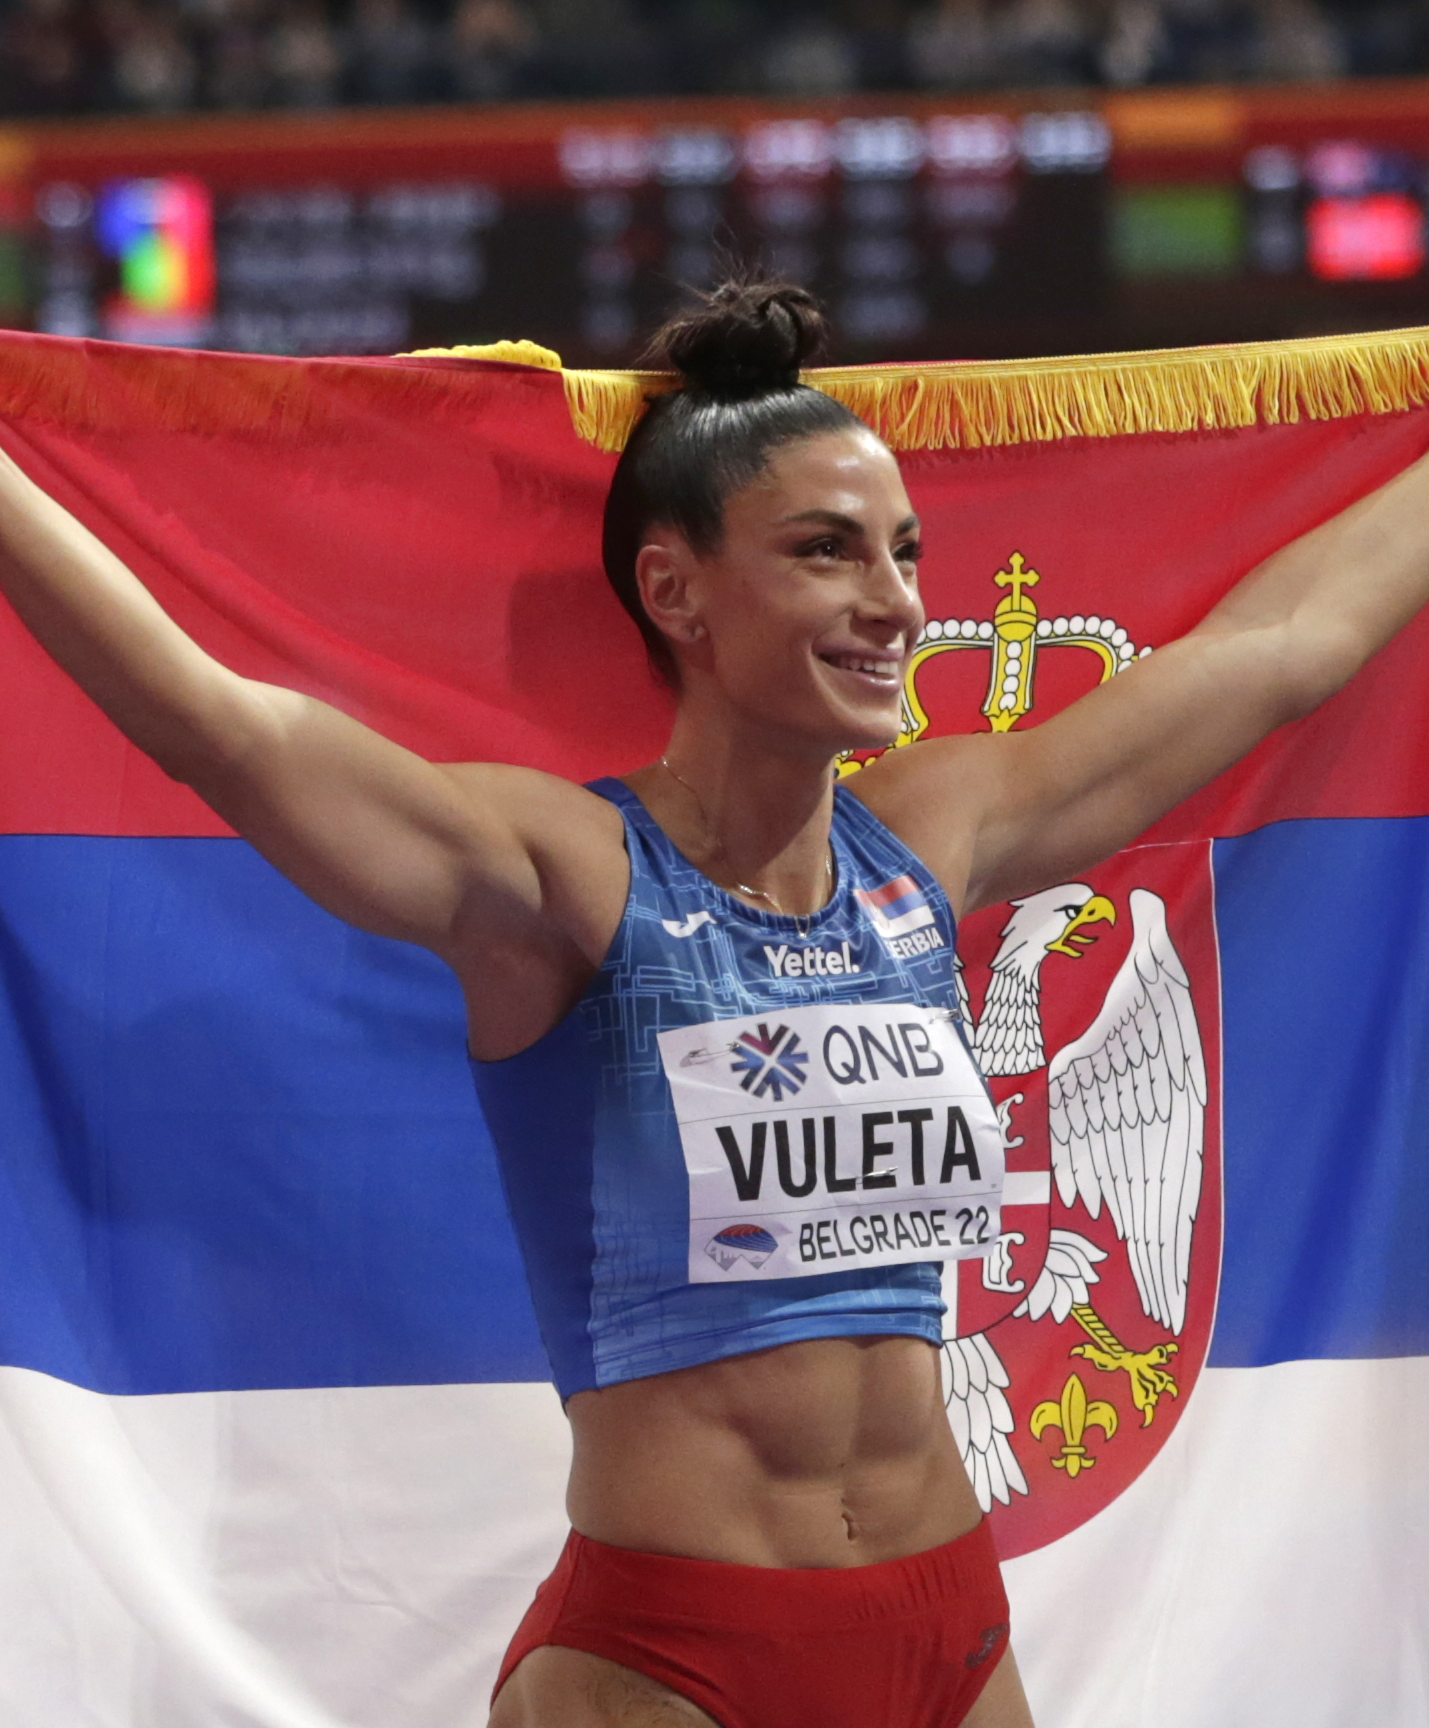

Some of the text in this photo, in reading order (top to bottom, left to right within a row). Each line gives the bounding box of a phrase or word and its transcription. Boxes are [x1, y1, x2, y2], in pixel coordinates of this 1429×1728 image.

[764, 941, 860, 977] Yettel.
[885, 927, 945, 959] ERBIA
[822, 1022, 945, 1085] QNB
[715, 1105, 982, 1202] VULETA
[799, 1205, 991, 1263] BELGRADE 22
